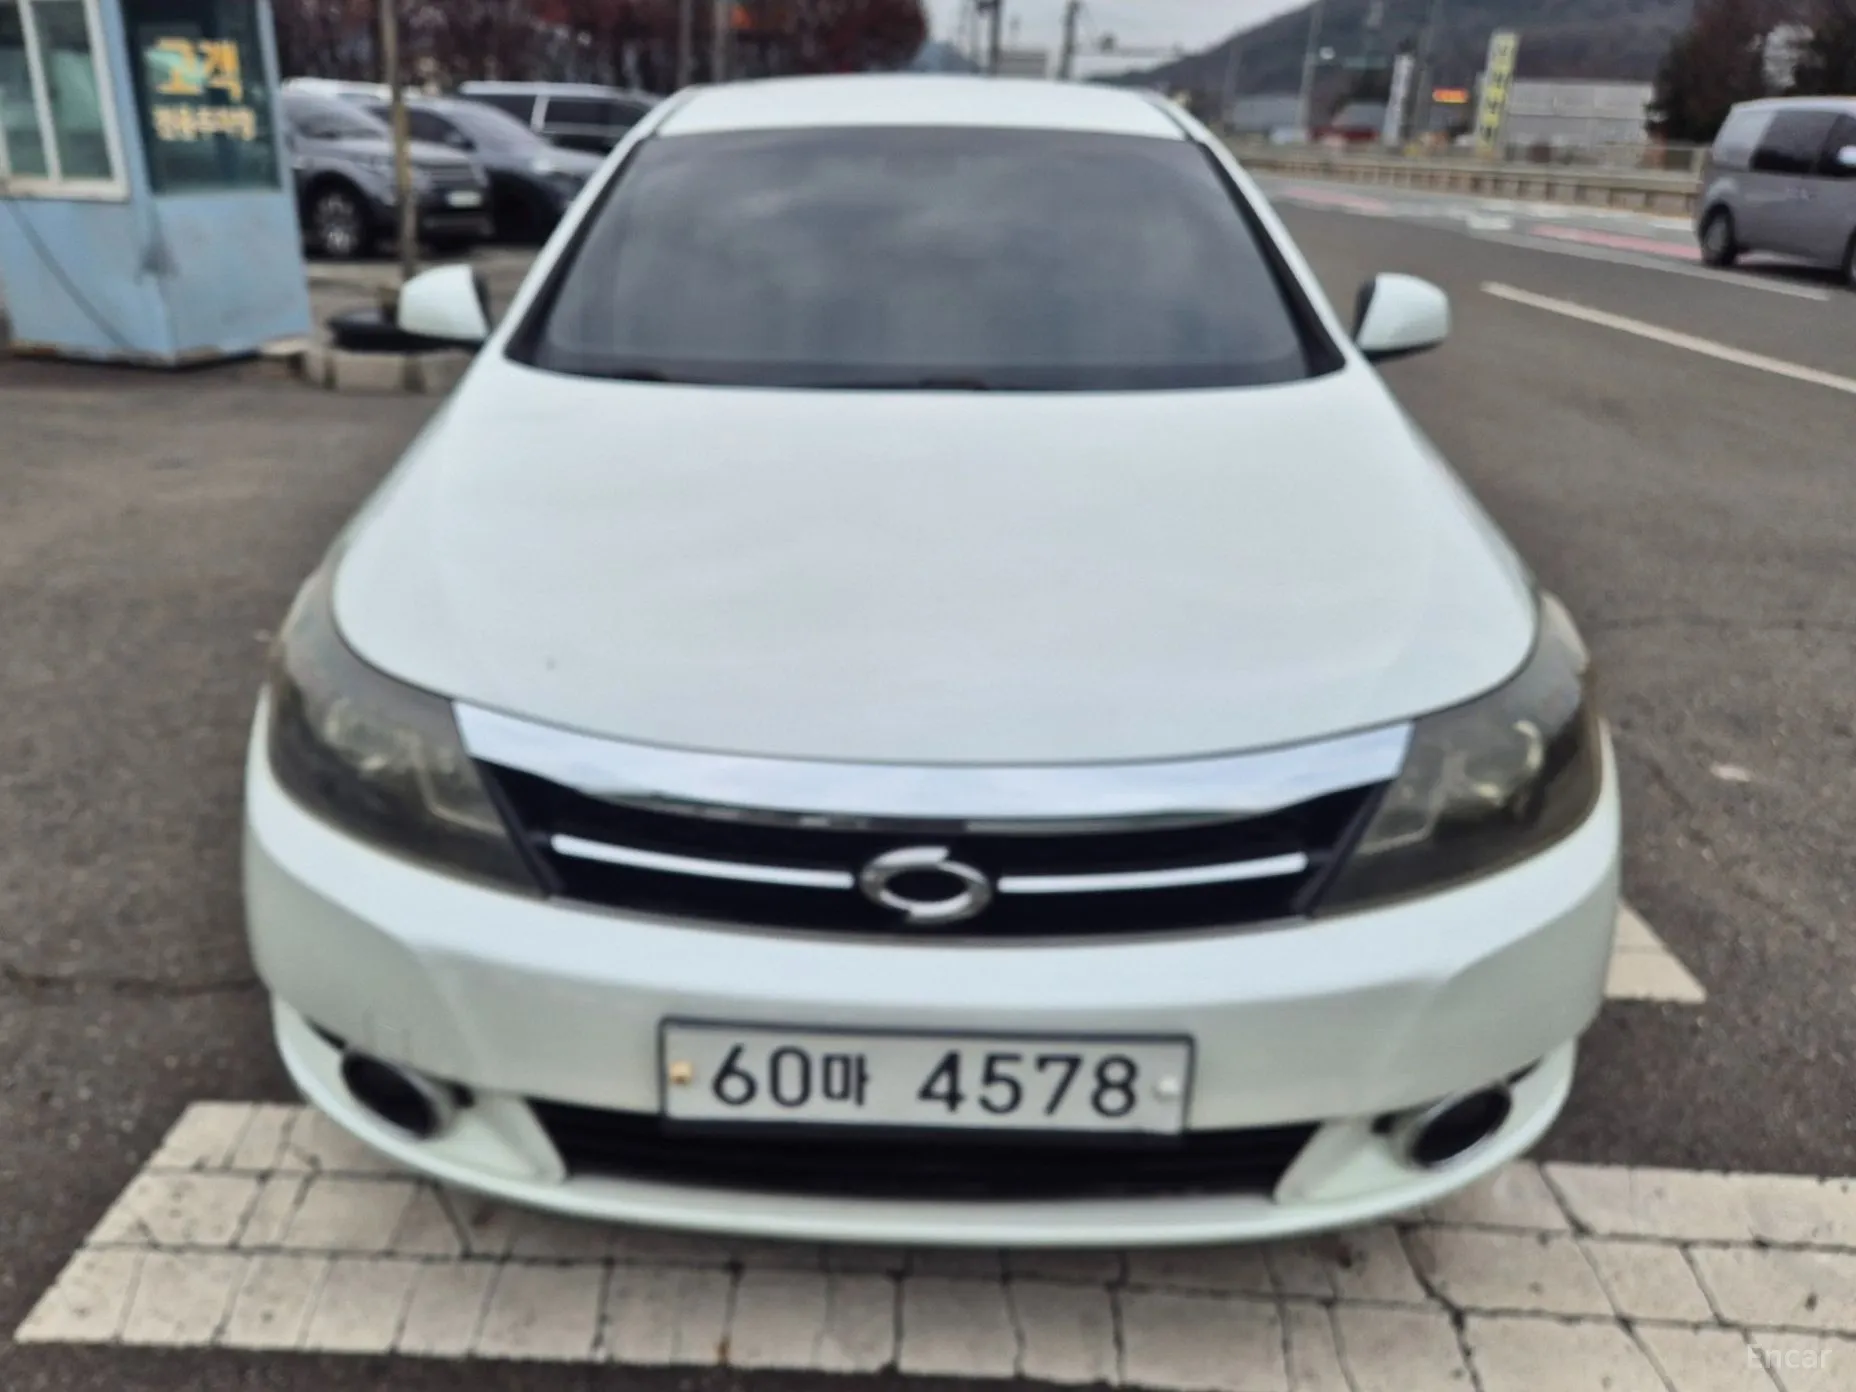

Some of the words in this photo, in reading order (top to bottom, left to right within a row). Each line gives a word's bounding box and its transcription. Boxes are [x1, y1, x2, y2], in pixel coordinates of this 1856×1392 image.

[155, 37, 242, 103] 고객
[712, 1044, 869, 1107] 60마
[917, 1050, 1139, 1117] 4578
